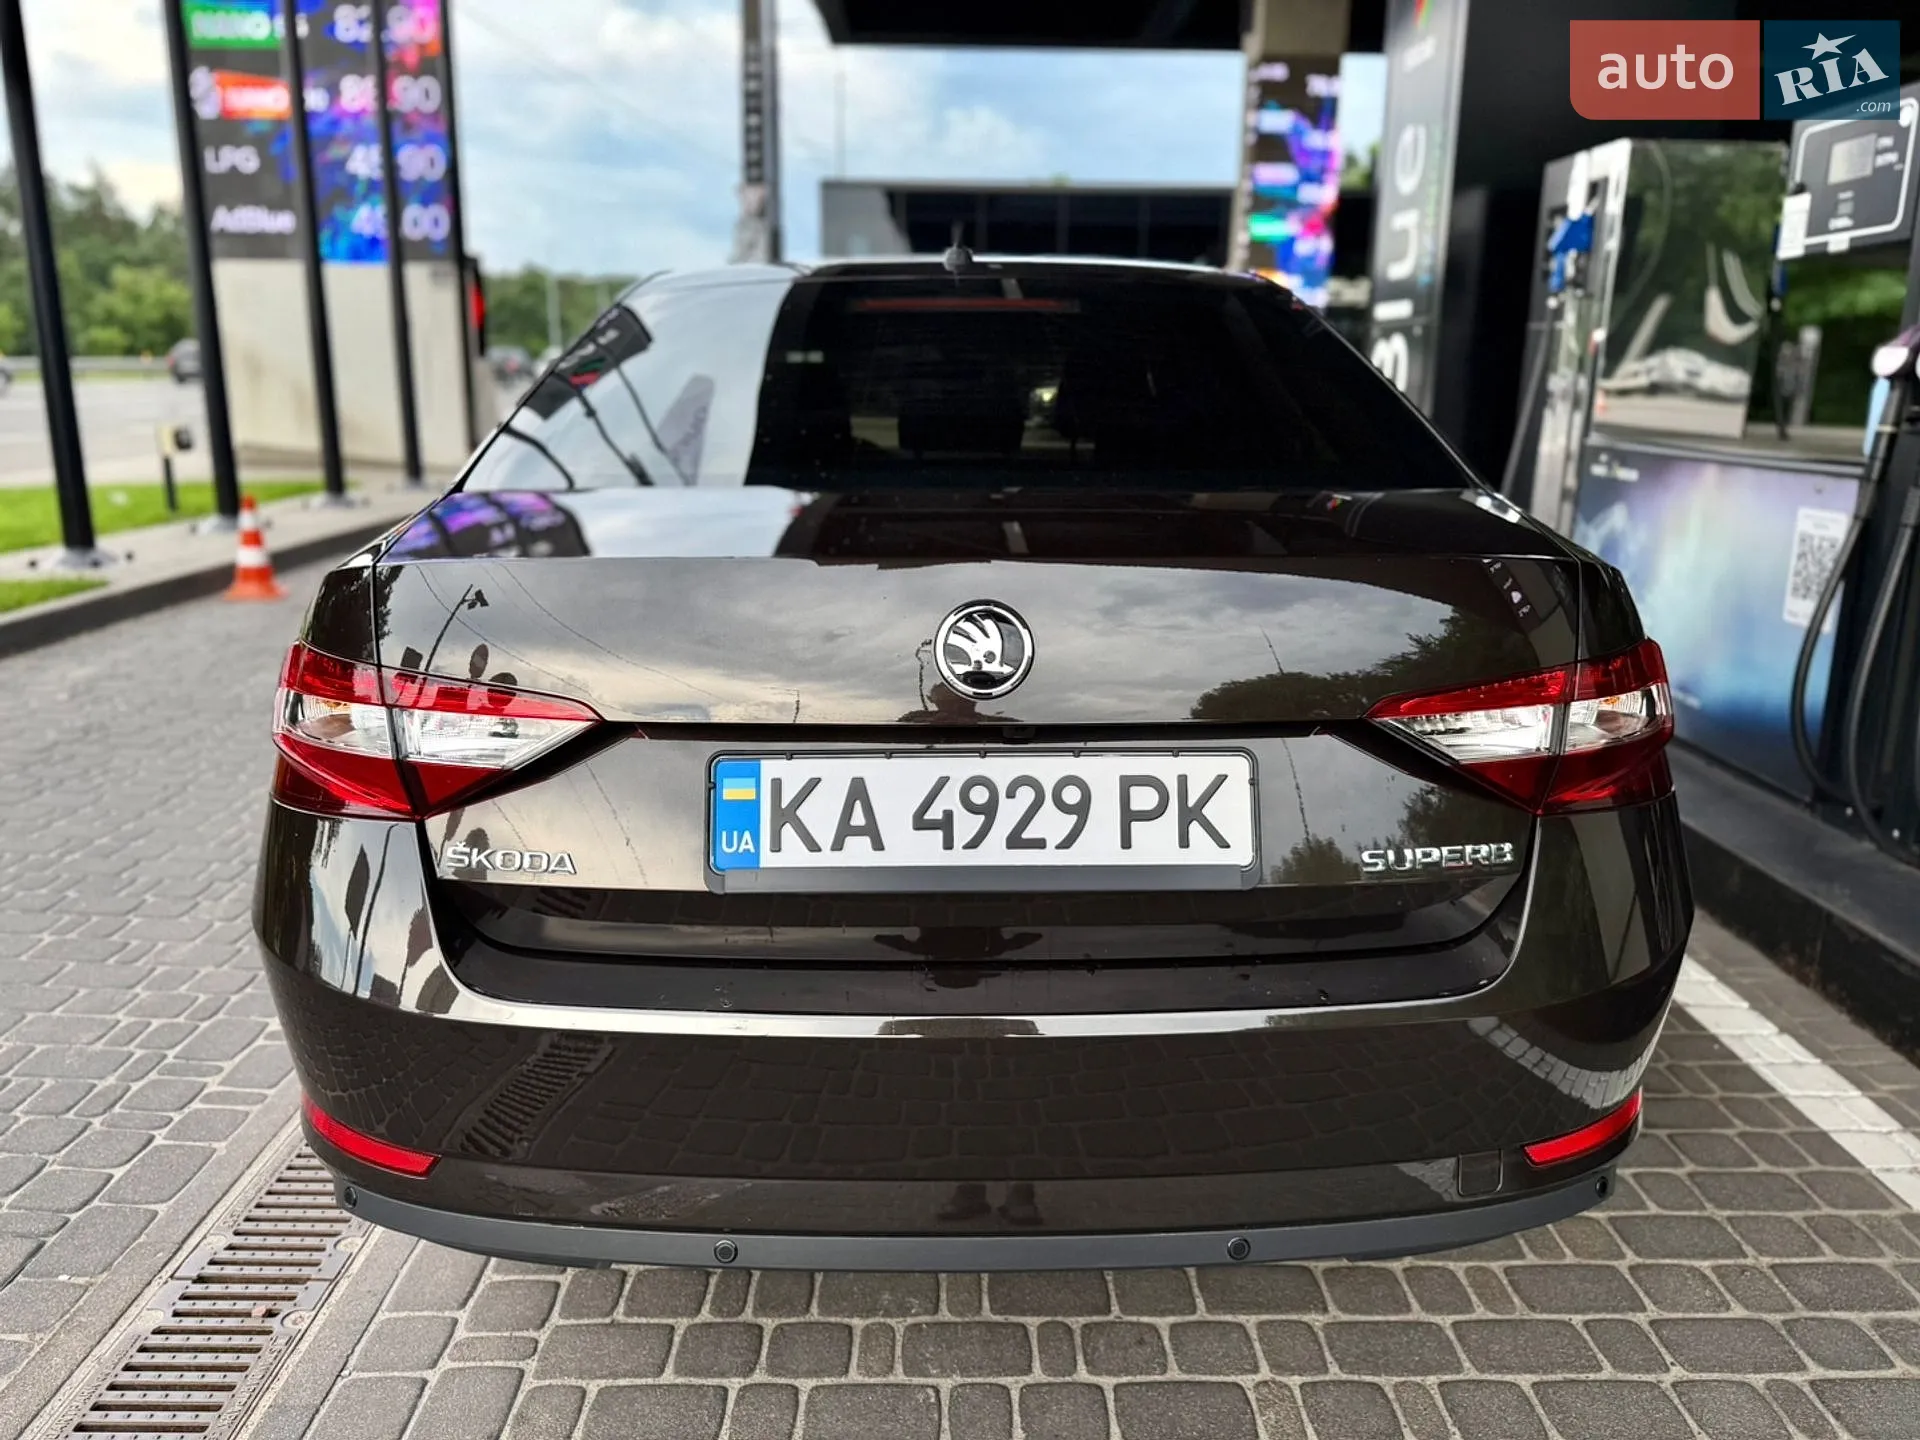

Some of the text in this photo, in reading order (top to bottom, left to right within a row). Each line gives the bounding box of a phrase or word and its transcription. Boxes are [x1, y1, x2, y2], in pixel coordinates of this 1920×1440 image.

[204, 145, 260, 174] LPG
[210, 204, 297, 235] AdBlue
[769, 773, 1230, 853] KA 4929 PK
[446, 841, 577, 875] ŠKODA
[721, 831, 755, 854] UA
[1360, 842, 1515, 873] SUPERB
